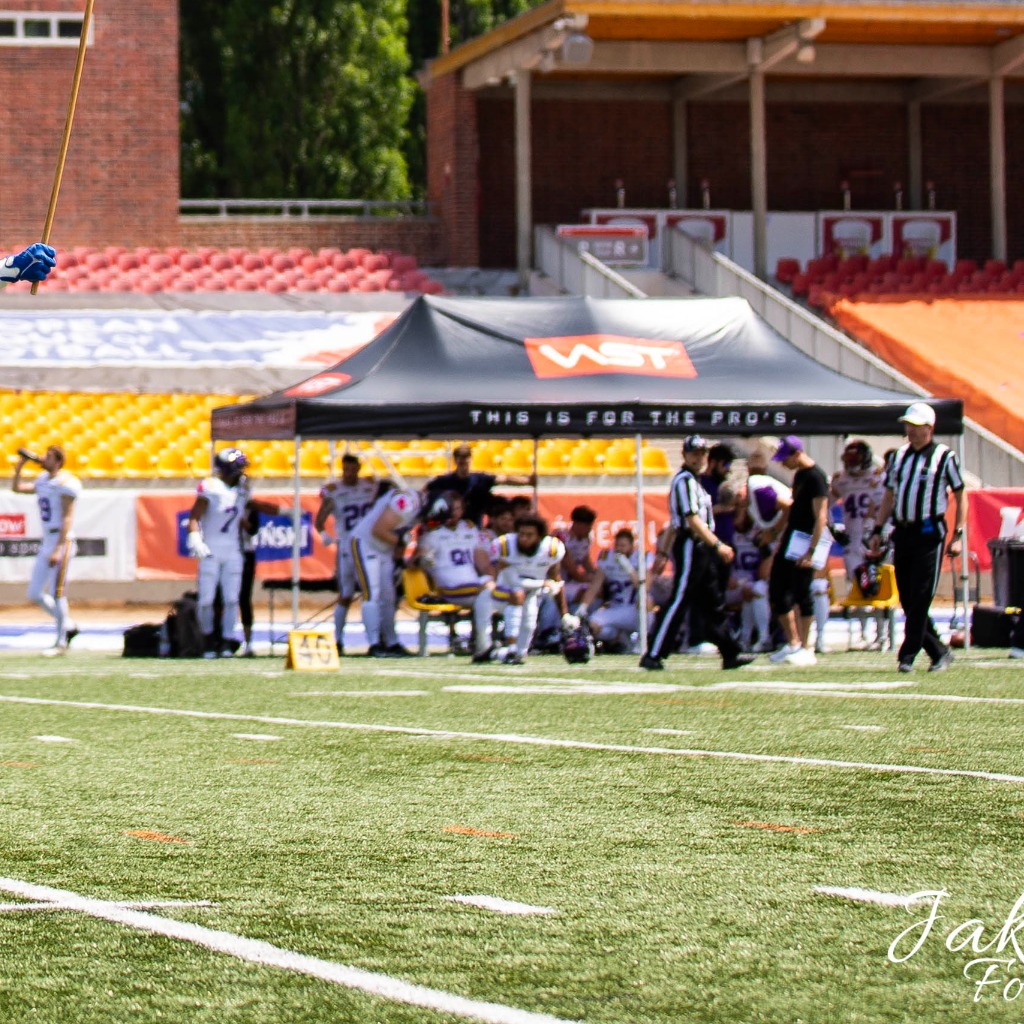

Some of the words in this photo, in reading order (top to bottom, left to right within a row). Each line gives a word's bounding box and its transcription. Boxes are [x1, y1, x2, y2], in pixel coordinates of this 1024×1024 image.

[470, 411, 529, 424] THIS
[545, 411, 570, 424] IS
[587, 411, 635, 425] FOR
[650, 411, 695, 425] THE
[221, 506, 238, 533] 7
